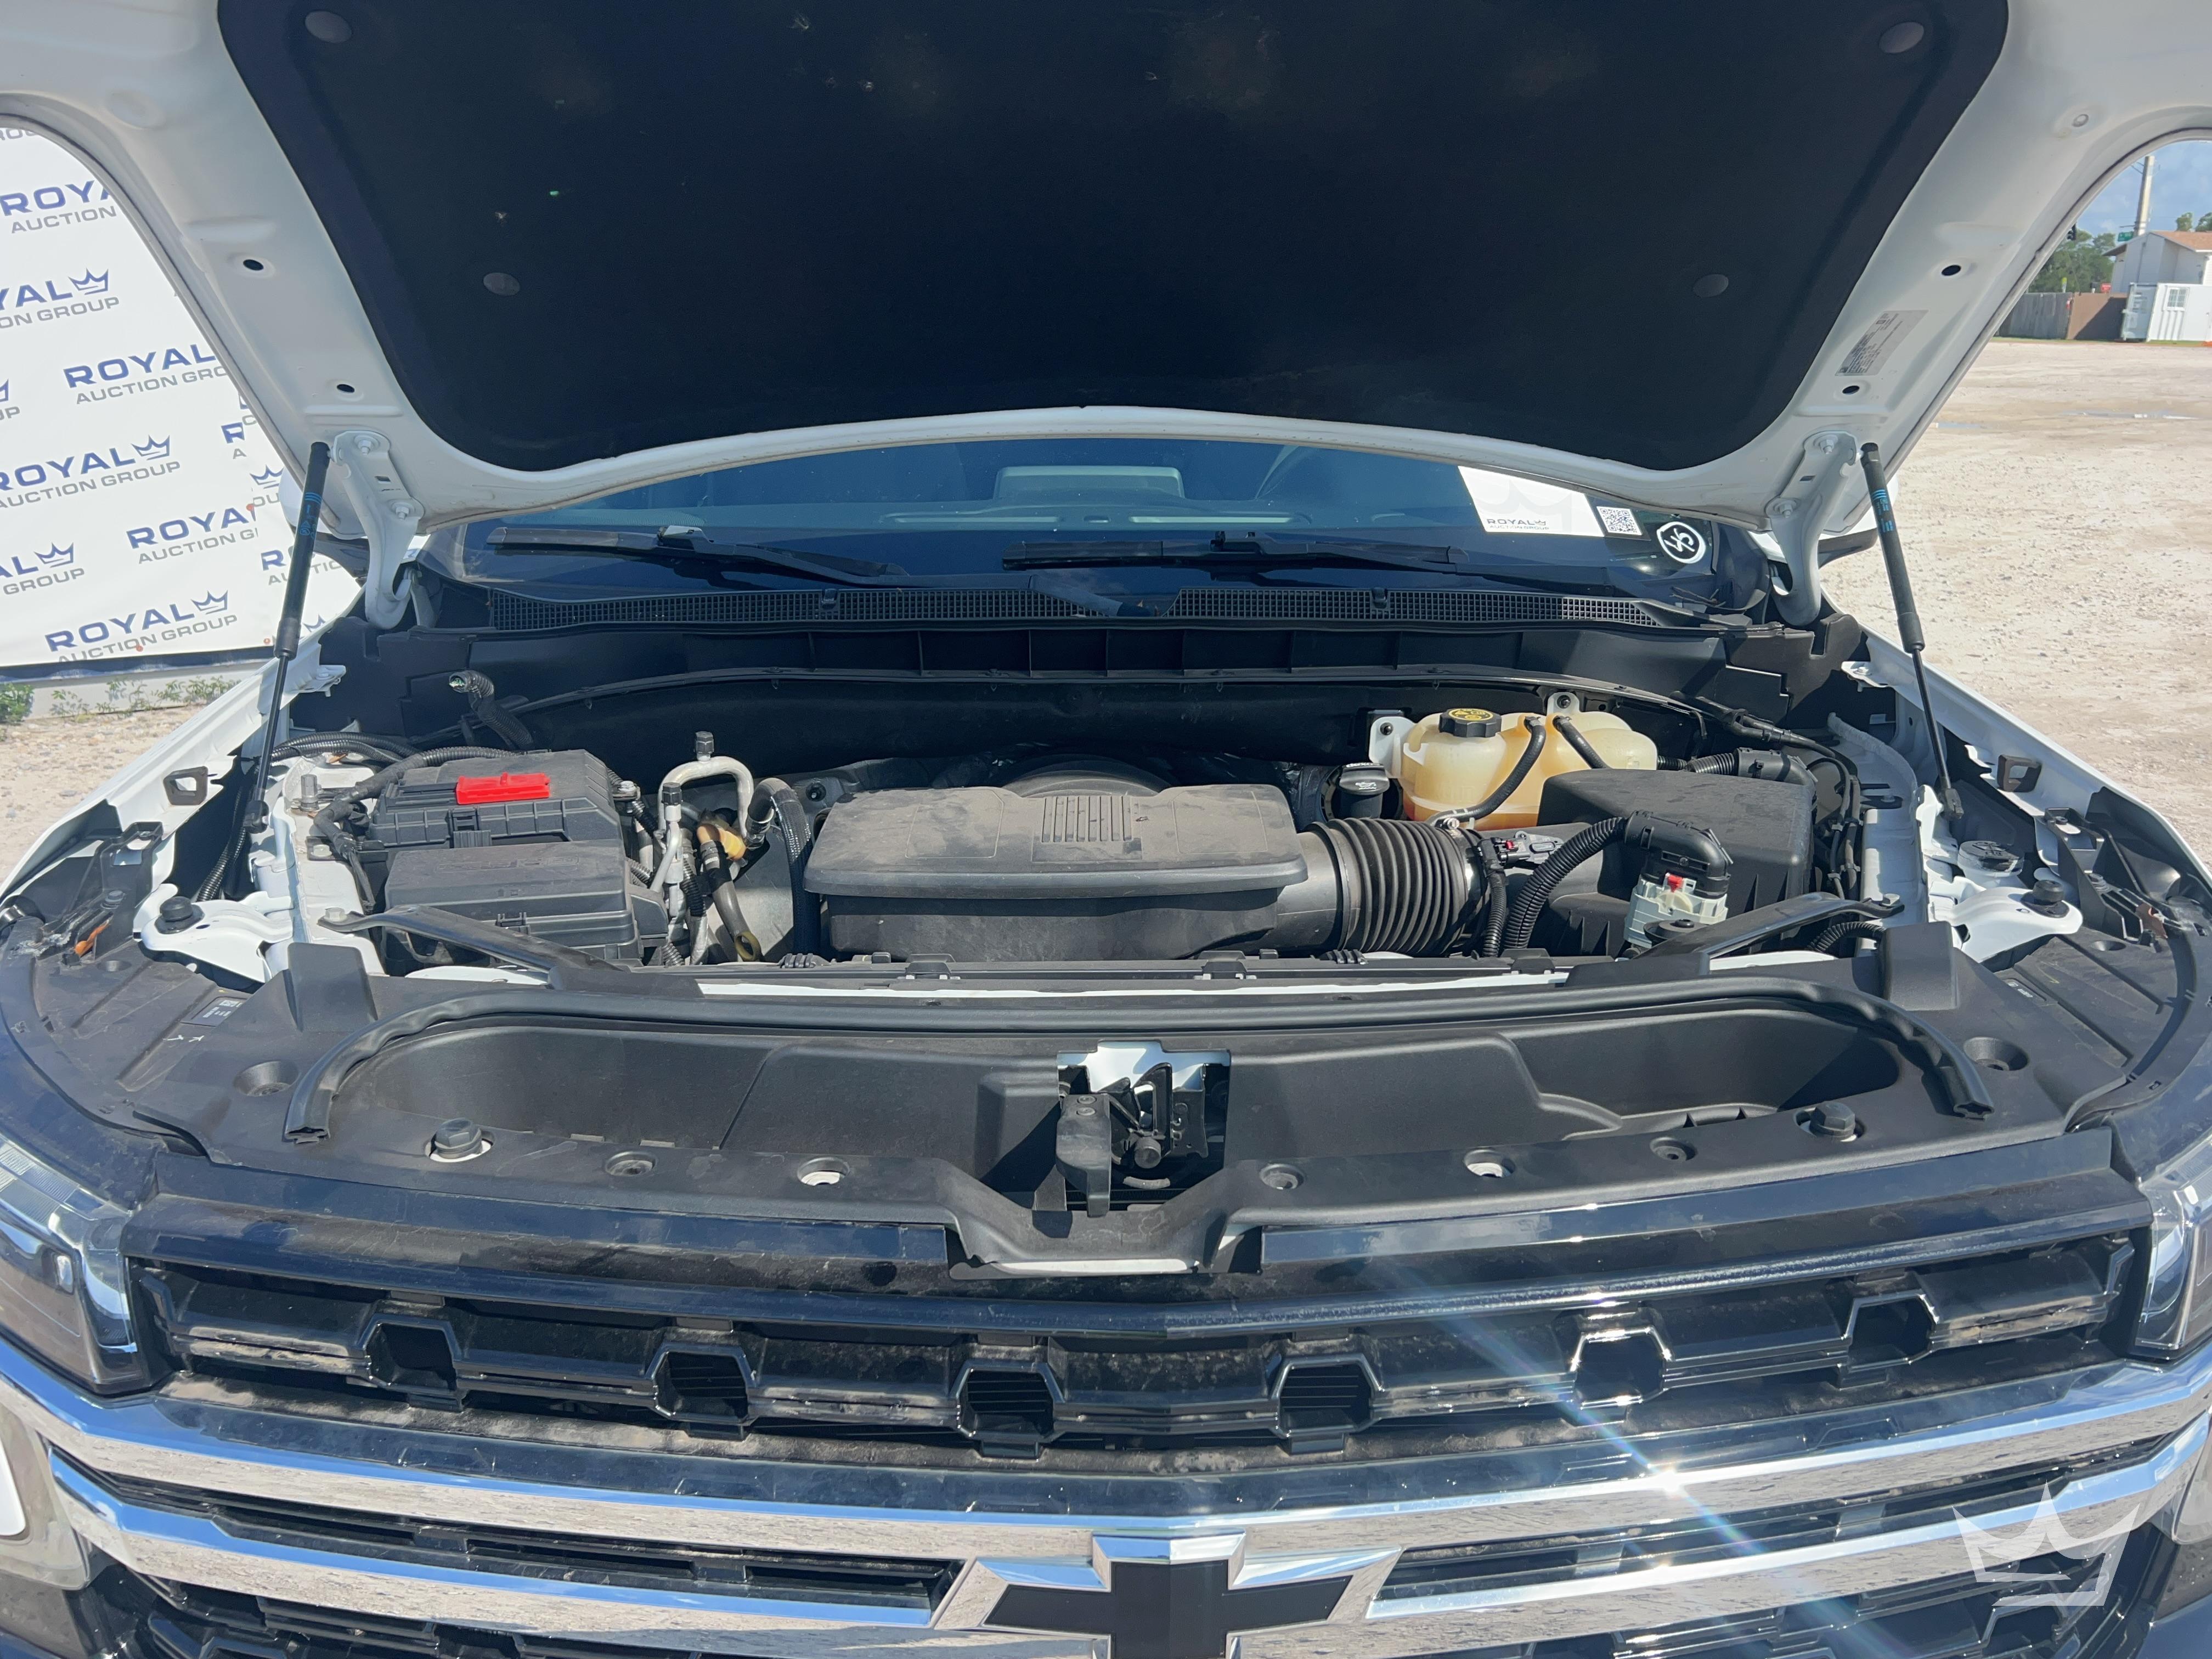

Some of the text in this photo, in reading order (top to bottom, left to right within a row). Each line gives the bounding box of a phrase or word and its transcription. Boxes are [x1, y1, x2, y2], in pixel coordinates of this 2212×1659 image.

[12, 206, 116, 233] AUCTION
[37, 297, 119, 321] GROUP
[63, 344, 216, 388] ROYAL
[76, 375, 178, 404] AUCTION
[101, 461, 180, 487] GROUP
[126, 507, 256, 549] ROYA
[139, 533, 236, 564] AUCTION
[3, 568, 84, 595] GROUP
[44, 604, 194, 652] ROYAL
[161, 615, 237, 641] GROUP
